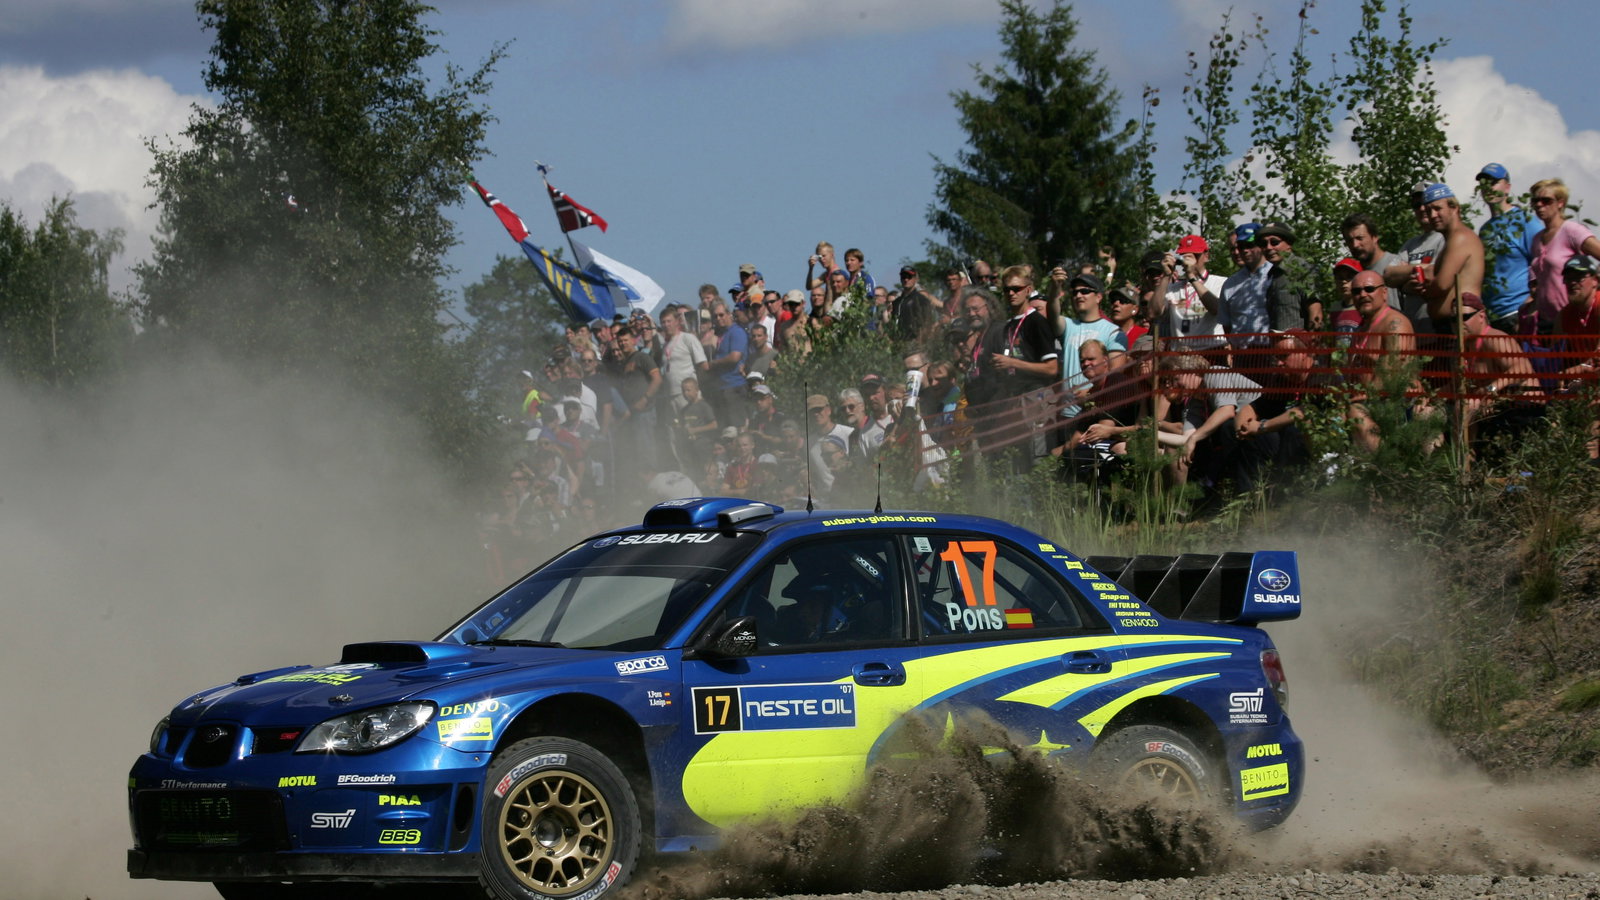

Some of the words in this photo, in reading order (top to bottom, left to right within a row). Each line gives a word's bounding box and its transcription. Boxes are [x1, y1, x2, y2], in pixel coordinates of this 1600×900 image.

[822, 515, 937, 526] subaru-global.com
[617, 532, 721, 545] SUBARU
[856, 557, 879, 577] parco
[940, 541, 998, 607] 17
[1099, 592, 1130, 601] Snap-on
[1253, 593, 1300, 604] SUBARU
[946, 602, 1004, 631] Pons
[1120, 618, 1159, 627] KENWOOD
[617, 656, 666, 674] sparco
[839, 685, 852, 694] '07
[440, 699, 500, 717] DENSO
[705, 695, 731, 726] 17
[746, 700, 819, 717] NESTE
[821, 698, 853, 715] OIL
[440, 720, 481, 731] BENTO
[1246, 743, 1283, 758] MOTUL
[337, 773, 396, 784] BFGoodrich
[497, 753, 567, 796] BFGoodrich
[1242, 769, 1279, 785] BENITO
[160, 779, 176, 789] STI
[175, 781, 227, 789] Performance
[278, 775, 317, 788] MOTUL
[378, 795, 422, 806] PIAA
[380, 830, 420, 843] BBS
